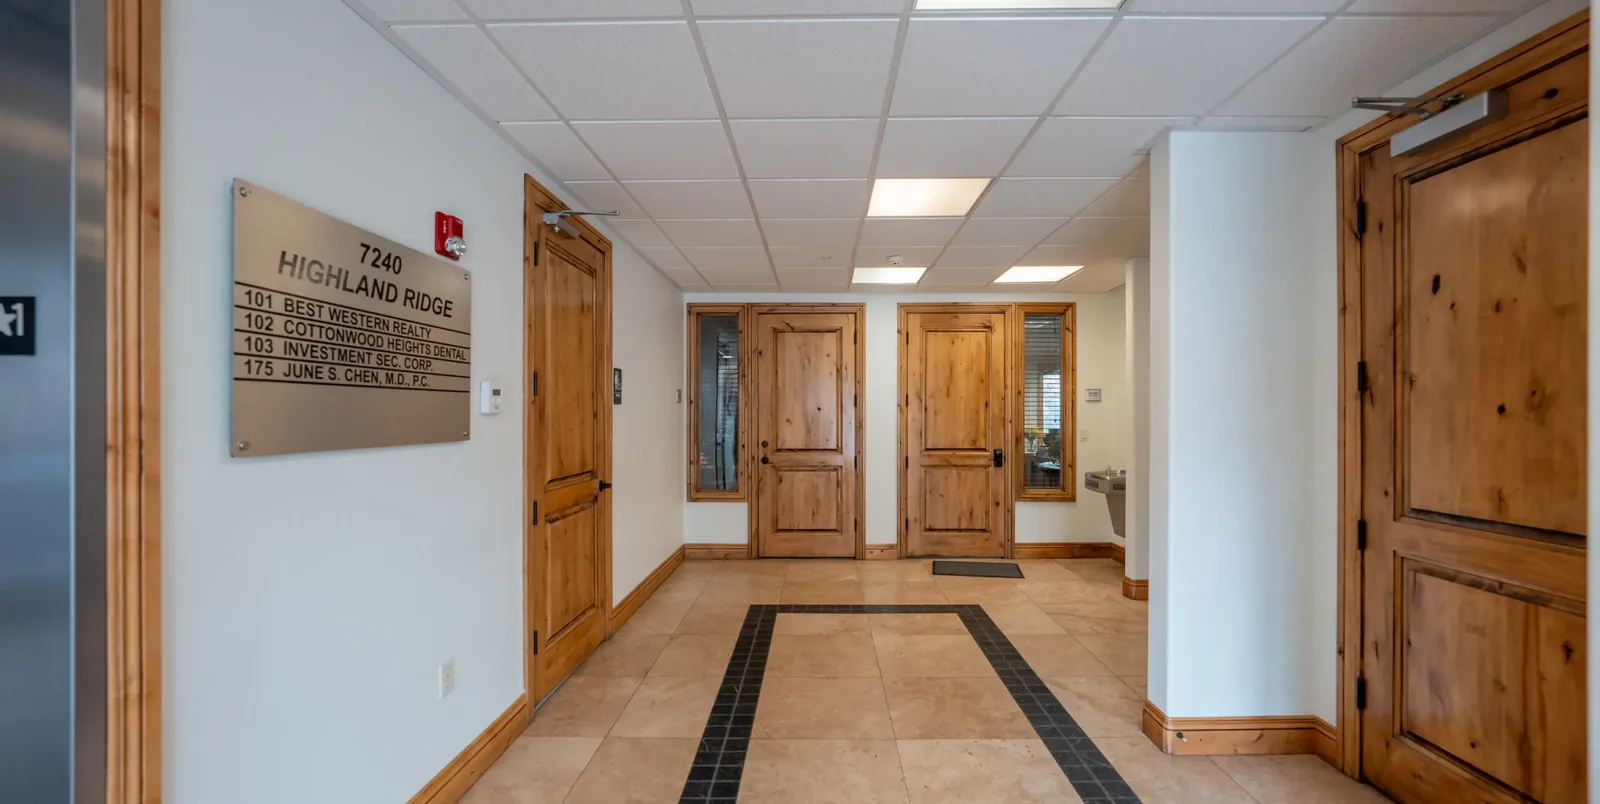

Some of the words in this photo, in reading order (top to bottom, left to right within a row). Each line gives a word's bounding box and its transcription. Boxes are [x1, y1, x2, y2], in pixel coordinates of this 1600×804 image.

[360, 243, 402, 274] 7240
[278, 250, 398, 304] HIGHLAND
[403, 288, 453, 318] RIDGE
[245, 290, 273, 309] 101
[284, 298, 324, 318] BEST
[329, 306, 389, 332] WESTERN
[393, 320, 431, 339] REALTY
[245, 314, 274, 331] 102
[284, 320, 383, 348] COTTONWOOD
[387, 338, 431, 356] HEIGHTS
[434, 346, 466, 361] DENTAL
[245, 337, 273, 353] 103
[284, 341, 372, 366] INVESTMENT
[376, 353, 401, 368] SEC.
[404, 358, 433, 372] CORP.
[244, 360, 273, 376] 175
[283, 363, 323, 380] JUNE
[328, 367, 340, 381] S.
[345, 368, 382, 385] CHEN,
[386, 372, 409, 386] M.D.,
[413, 375, 430, 387] P.C.
